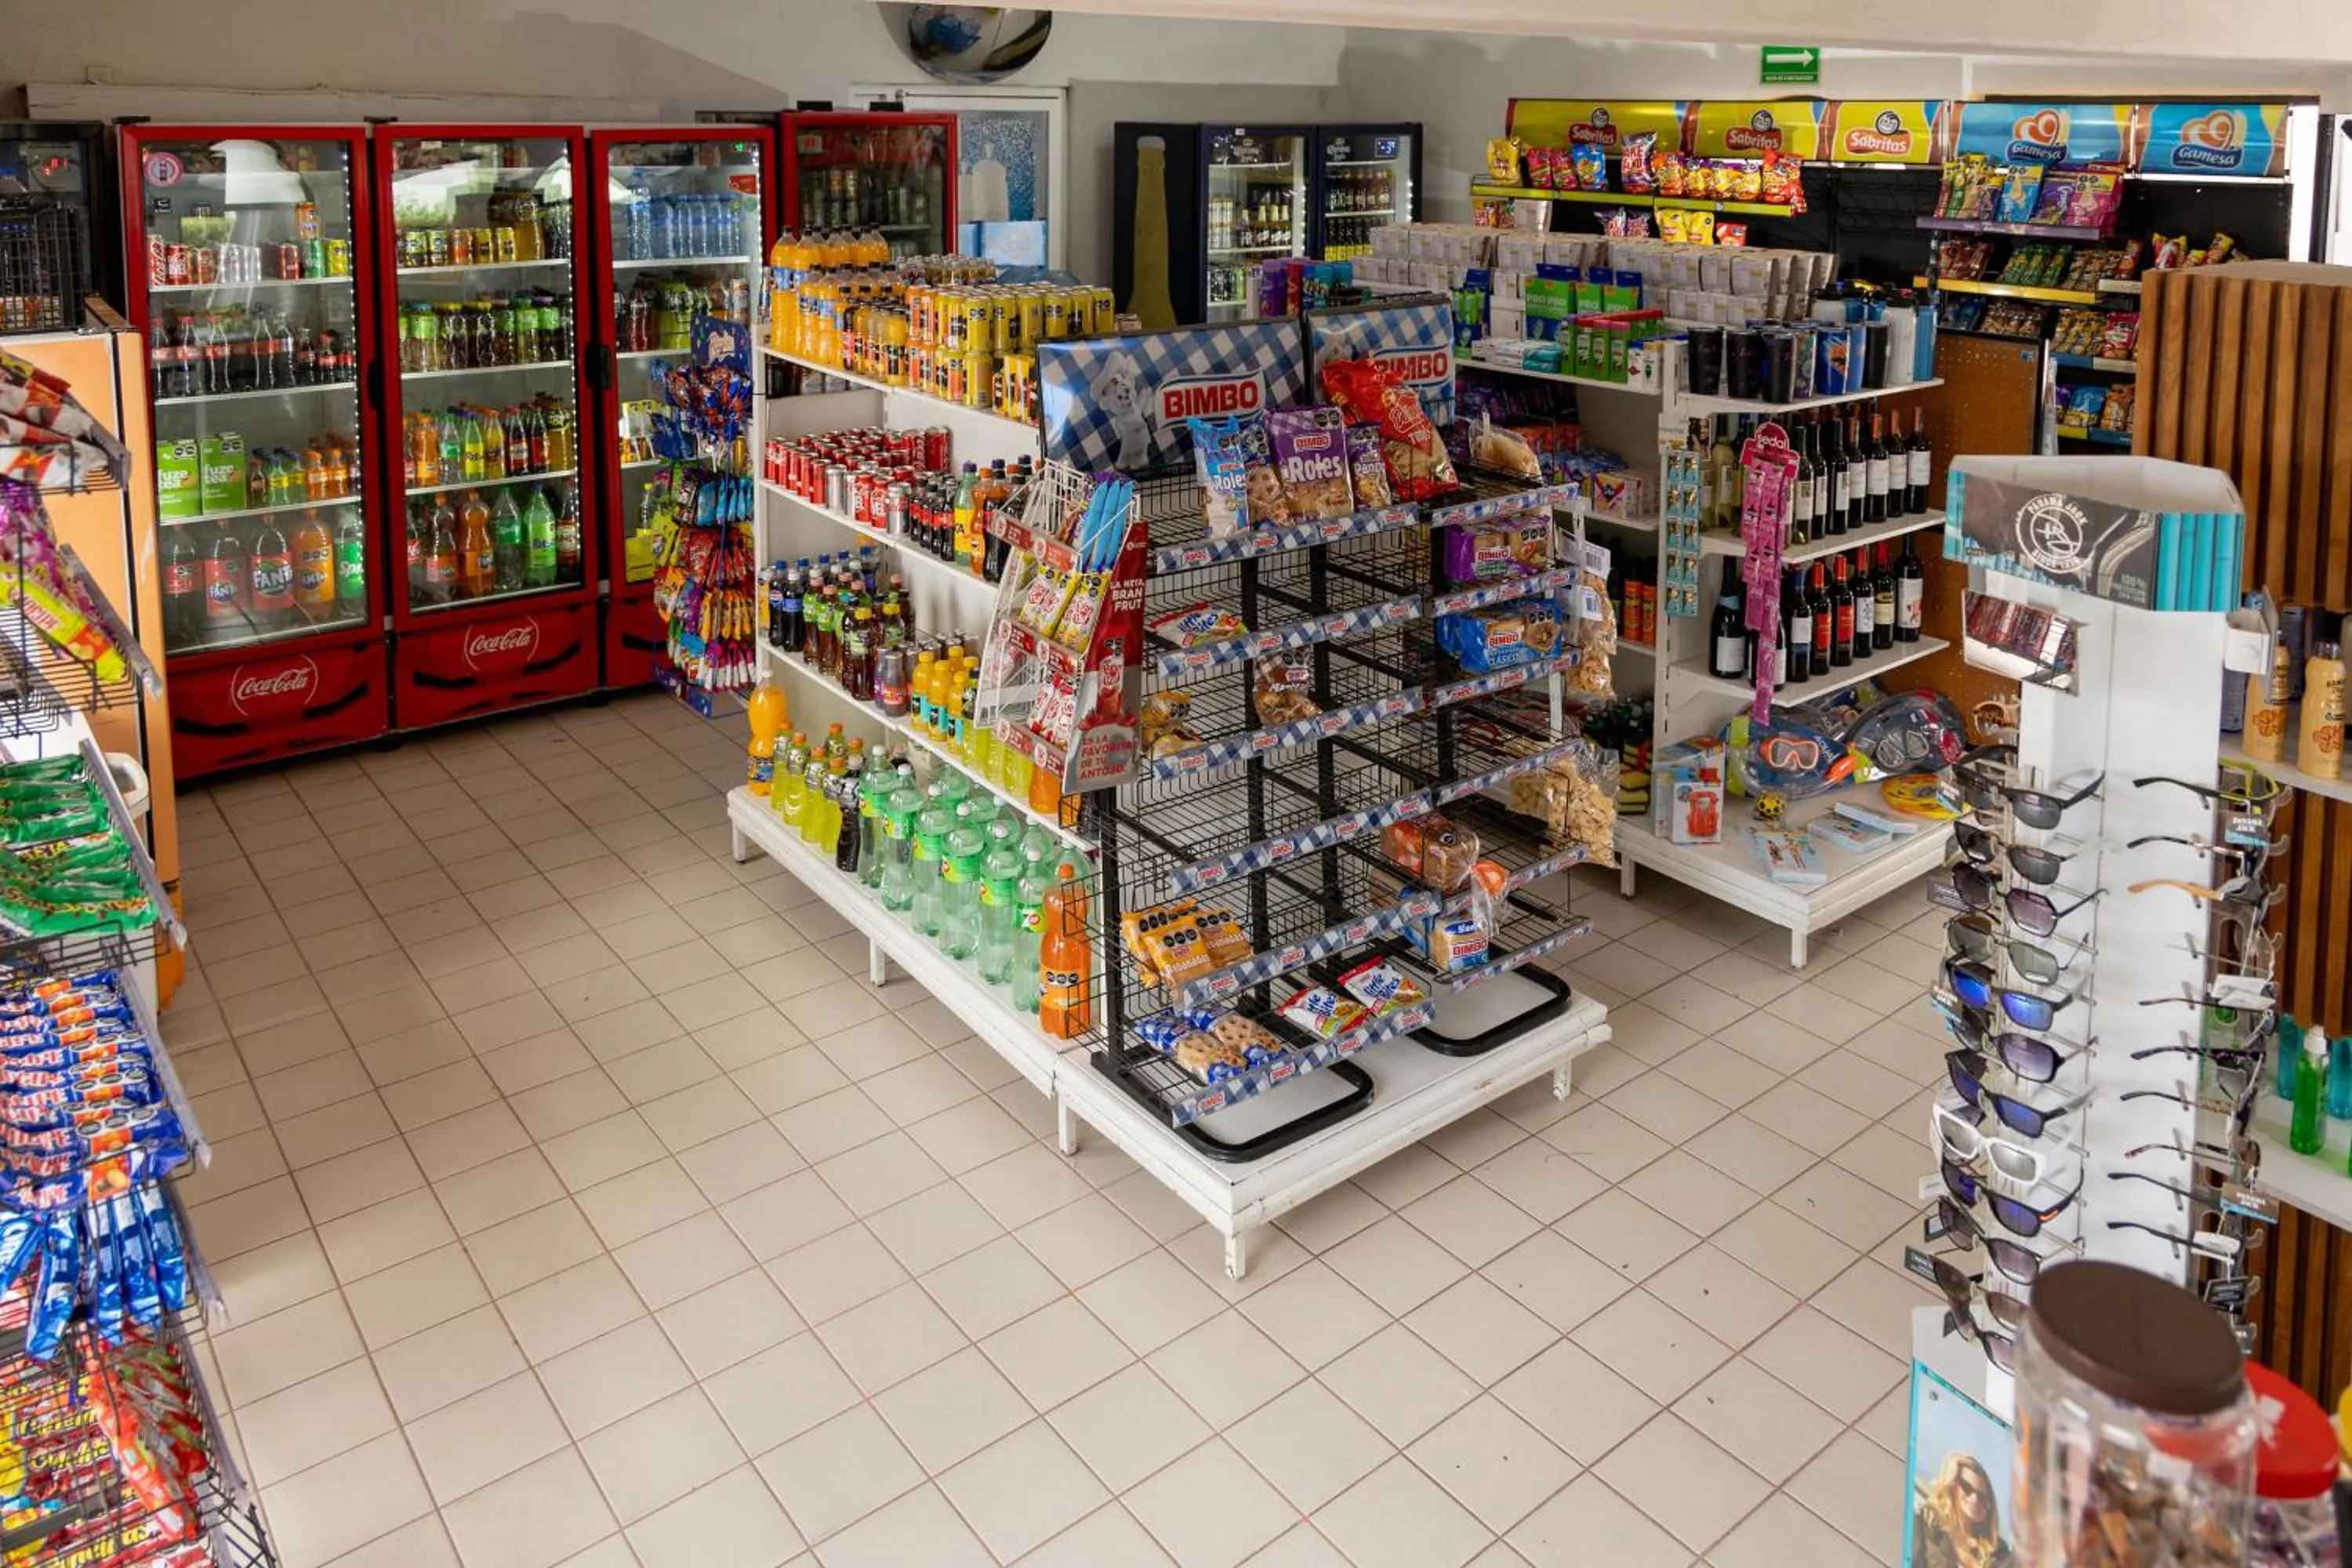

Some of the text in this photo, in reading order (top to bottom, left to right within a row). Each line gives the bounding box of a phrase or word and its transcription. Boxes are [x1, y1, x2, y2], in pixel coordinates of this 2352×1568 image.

[1572, 125, 1615, 143] Sabritas
[1729, 130, 1780, 149] Sabritas
[1850, 131, 1908, 152] Sabritas
[2012, 143, 2062, 161] Gamesa
[2179, 144, 2235, 165] Gamesa
[1577, 299, 1599, 310] PRO
[1163, 381, 1259, 419] BIMBO
[1757, 434, 1788, 449] sedal
[1288, 454, 1342, 484] Roles
[1213, 473, 1246, 493] Roles
[2027, 495, 2089, 525] PANAMA JACK
[1112, 588, 1143, 601] BRAN
[1114, 599, 1142, 612] FRUT
[470, 626, 535, 657] Coca-Cola
[238, 666, 313, 699] Coca-Cola
[1453, 938, 1487, 956] BIMBO
